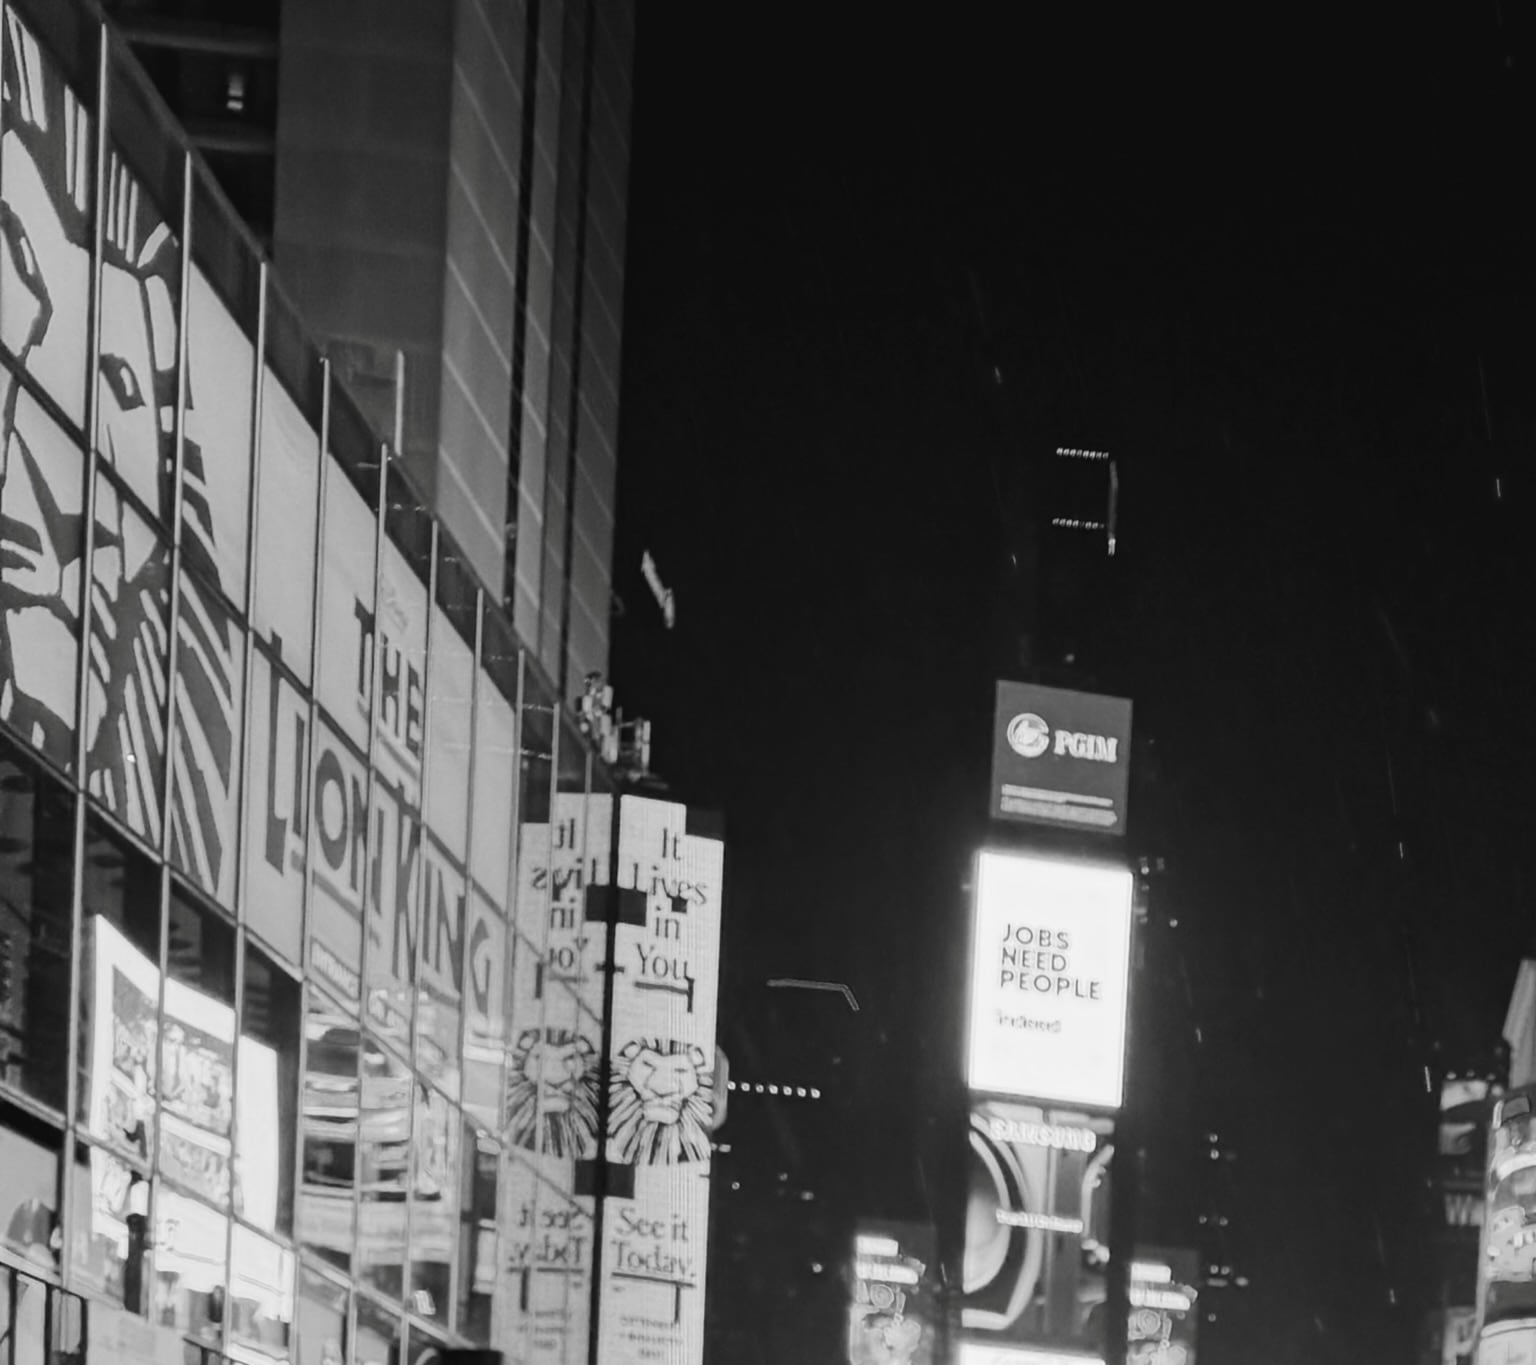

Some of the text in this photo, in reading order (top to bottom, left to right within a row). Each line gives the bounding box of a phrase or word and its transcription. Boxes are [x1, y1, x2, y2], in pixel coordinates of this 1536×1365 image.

[354, 597, 421, 758] THE
[1054, 729, 1118, 763] PGIM
[265, 628, 383, 917] LION
[392, 780, 490, 1018] KING
[661, 827, 682, 861] It
[632, 862, 708, 905] Lives
[655, 905, 681, 940] in
[1002, 923, 1070, 950] JOBS
[636, 942, 689, 980] You
[1001, 946, 1068, 972] NEED
[1000, 969, 1101, 1000] PEOPLE
[617, 1207, 689, 1243] See it
